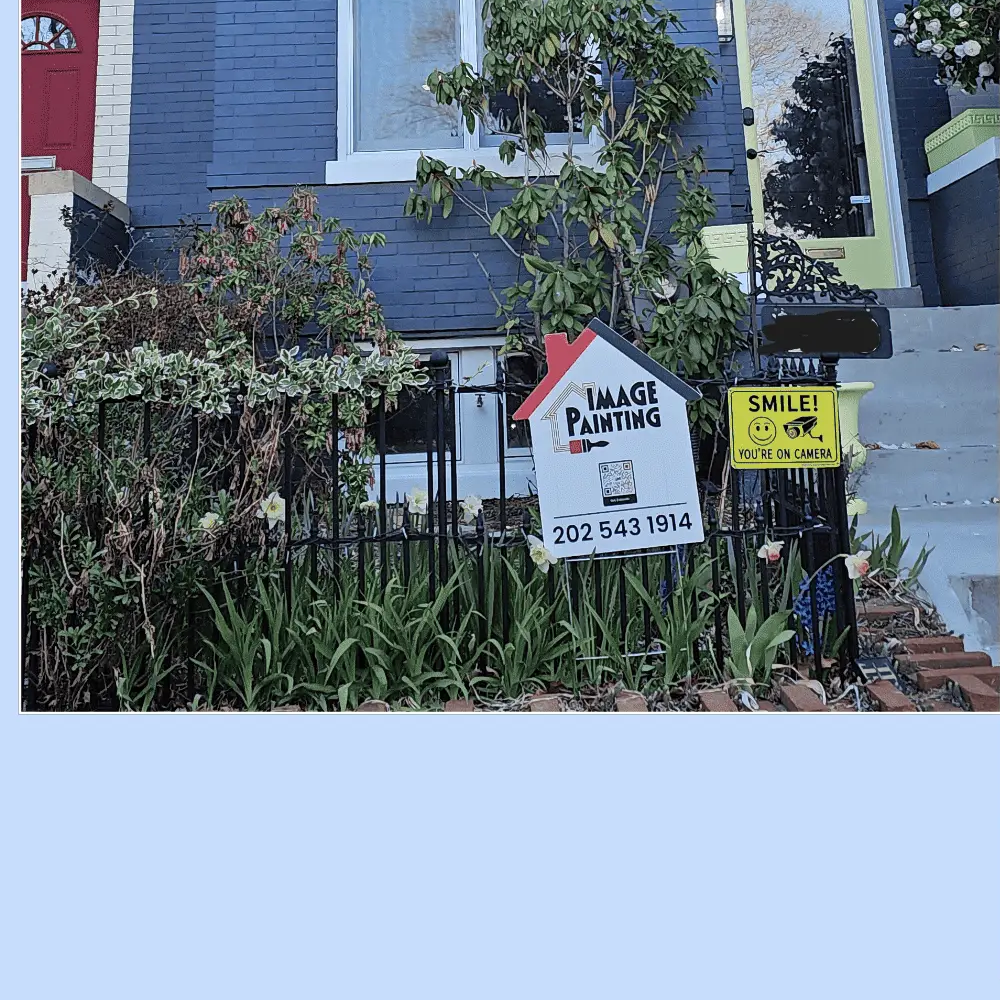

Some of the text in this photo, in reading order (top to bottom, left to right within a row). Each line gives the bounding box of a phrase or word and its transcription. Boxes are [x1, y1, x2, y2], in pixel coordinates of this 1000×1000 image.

[586, 381, 658, 411] IMAGE
[748, 394, 819, 413] SMILE!
[565, 407, 661, 437] PAINTING
[739, 447, 833, 460] YOU'RE ON CAMERA
[553, 512, 693, 545] 202 543 1914
